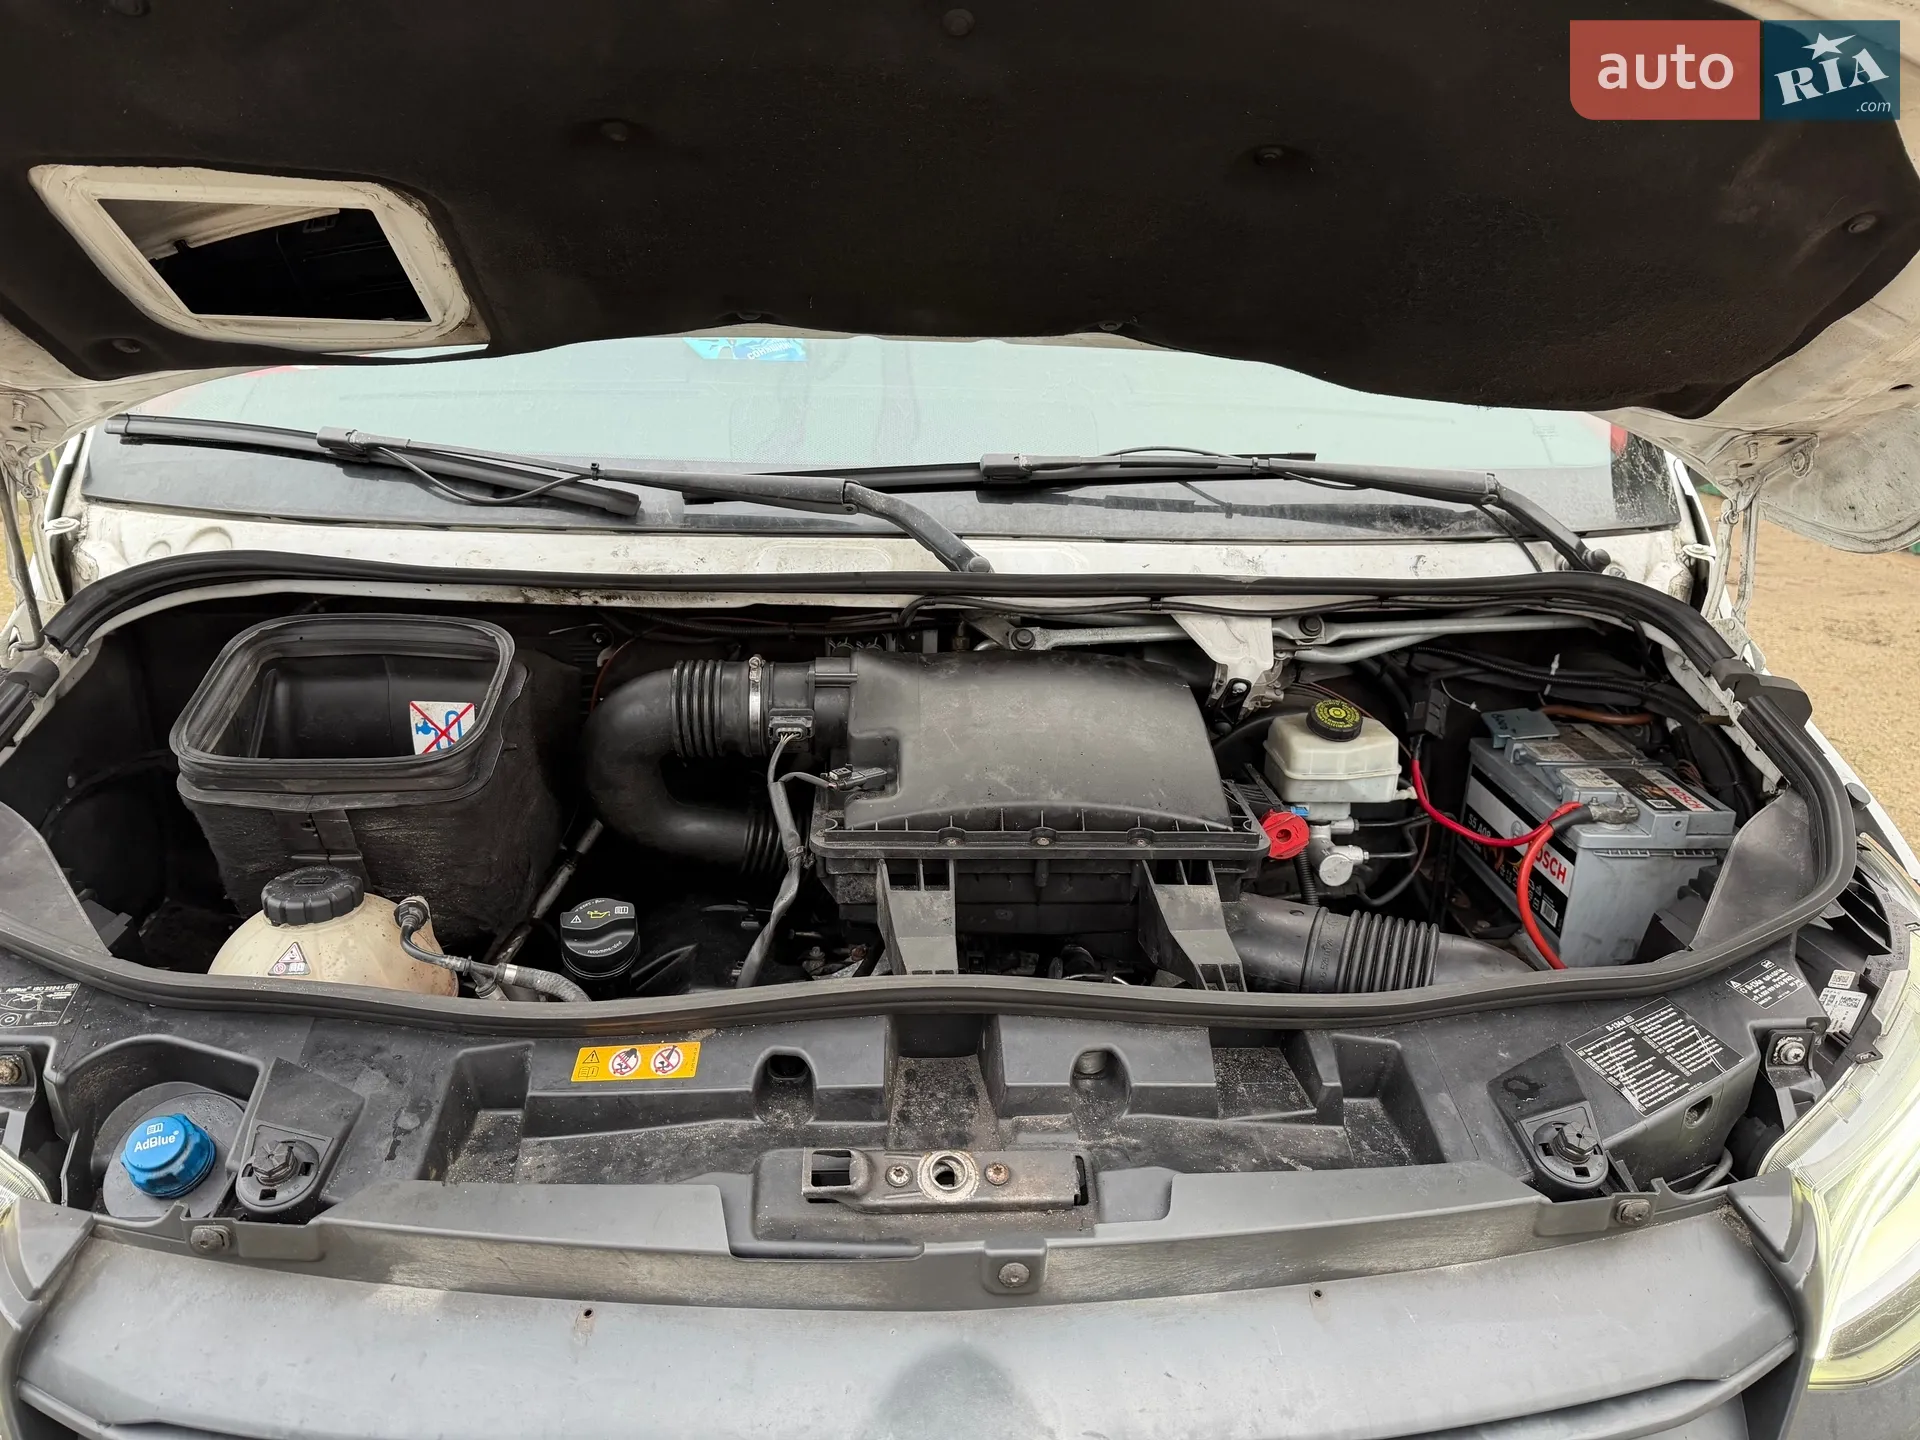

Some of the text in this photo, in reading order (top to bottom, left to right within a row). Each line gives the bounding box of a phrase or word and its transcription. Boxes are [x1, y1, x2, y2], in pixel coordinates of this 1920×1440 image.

[1667, 786, 1705, 809] BOSCH
[1535, 847, 1567, 885] OSCH
[1605, 1020, 1627, 1033] R-134a
